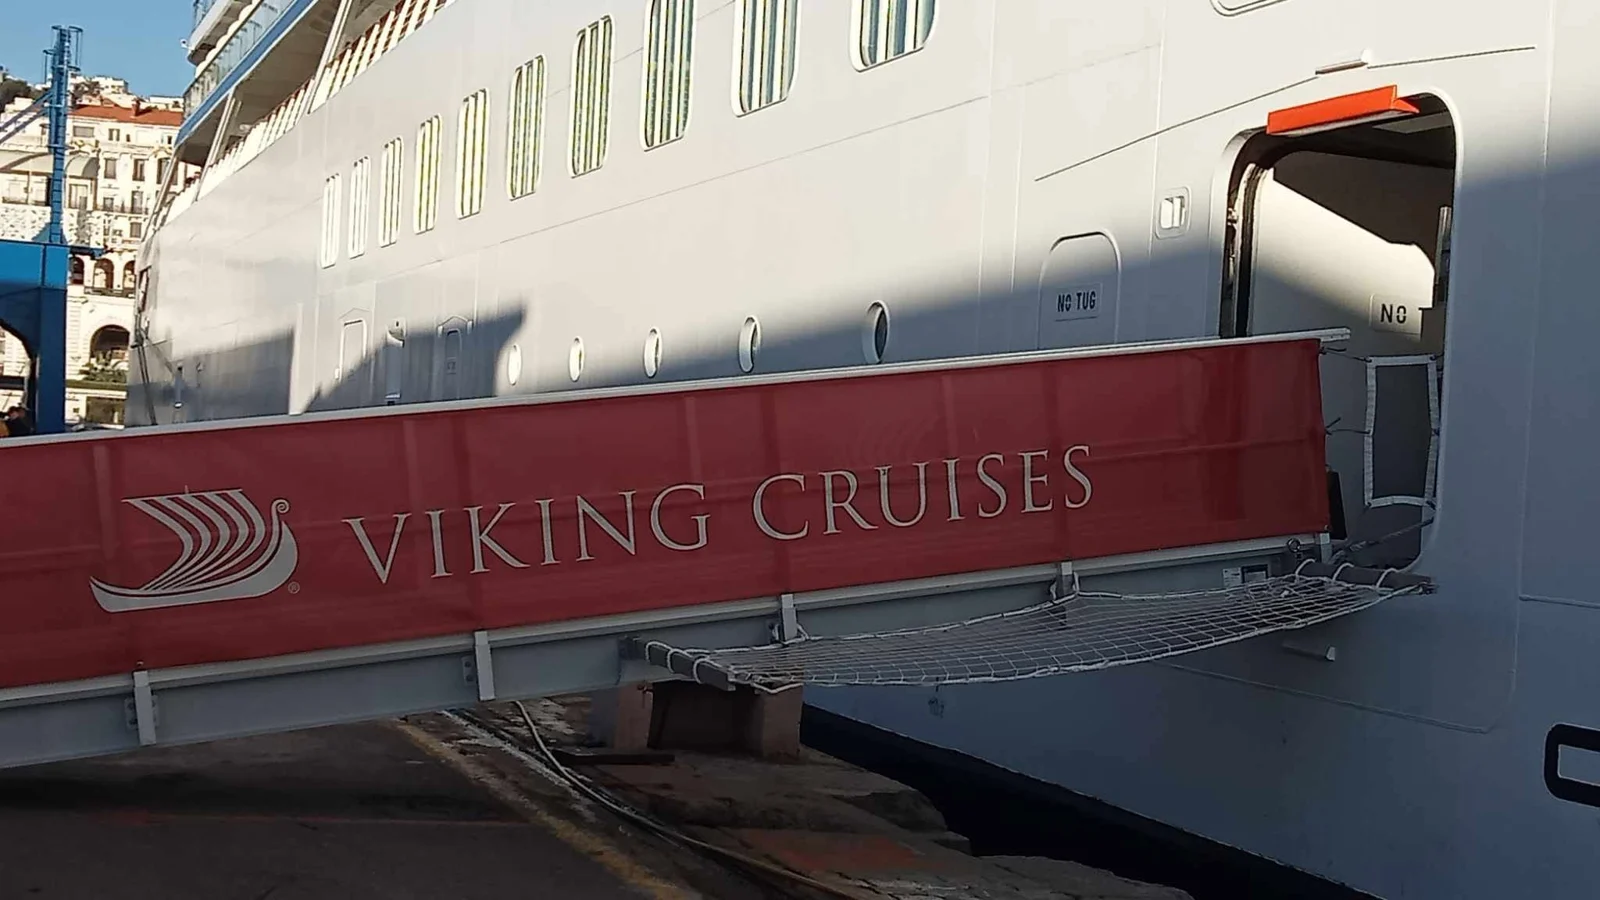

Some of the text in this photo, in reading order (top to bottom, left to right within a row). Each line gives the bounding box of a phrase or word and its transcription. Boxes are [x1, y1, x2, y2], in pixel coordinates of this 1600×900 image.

[1057, 290, 1096, 312] NO TUG
[1380, 303, 1407, 324] NO
[341, 444, 1093, 585] VIKING CRUISES
